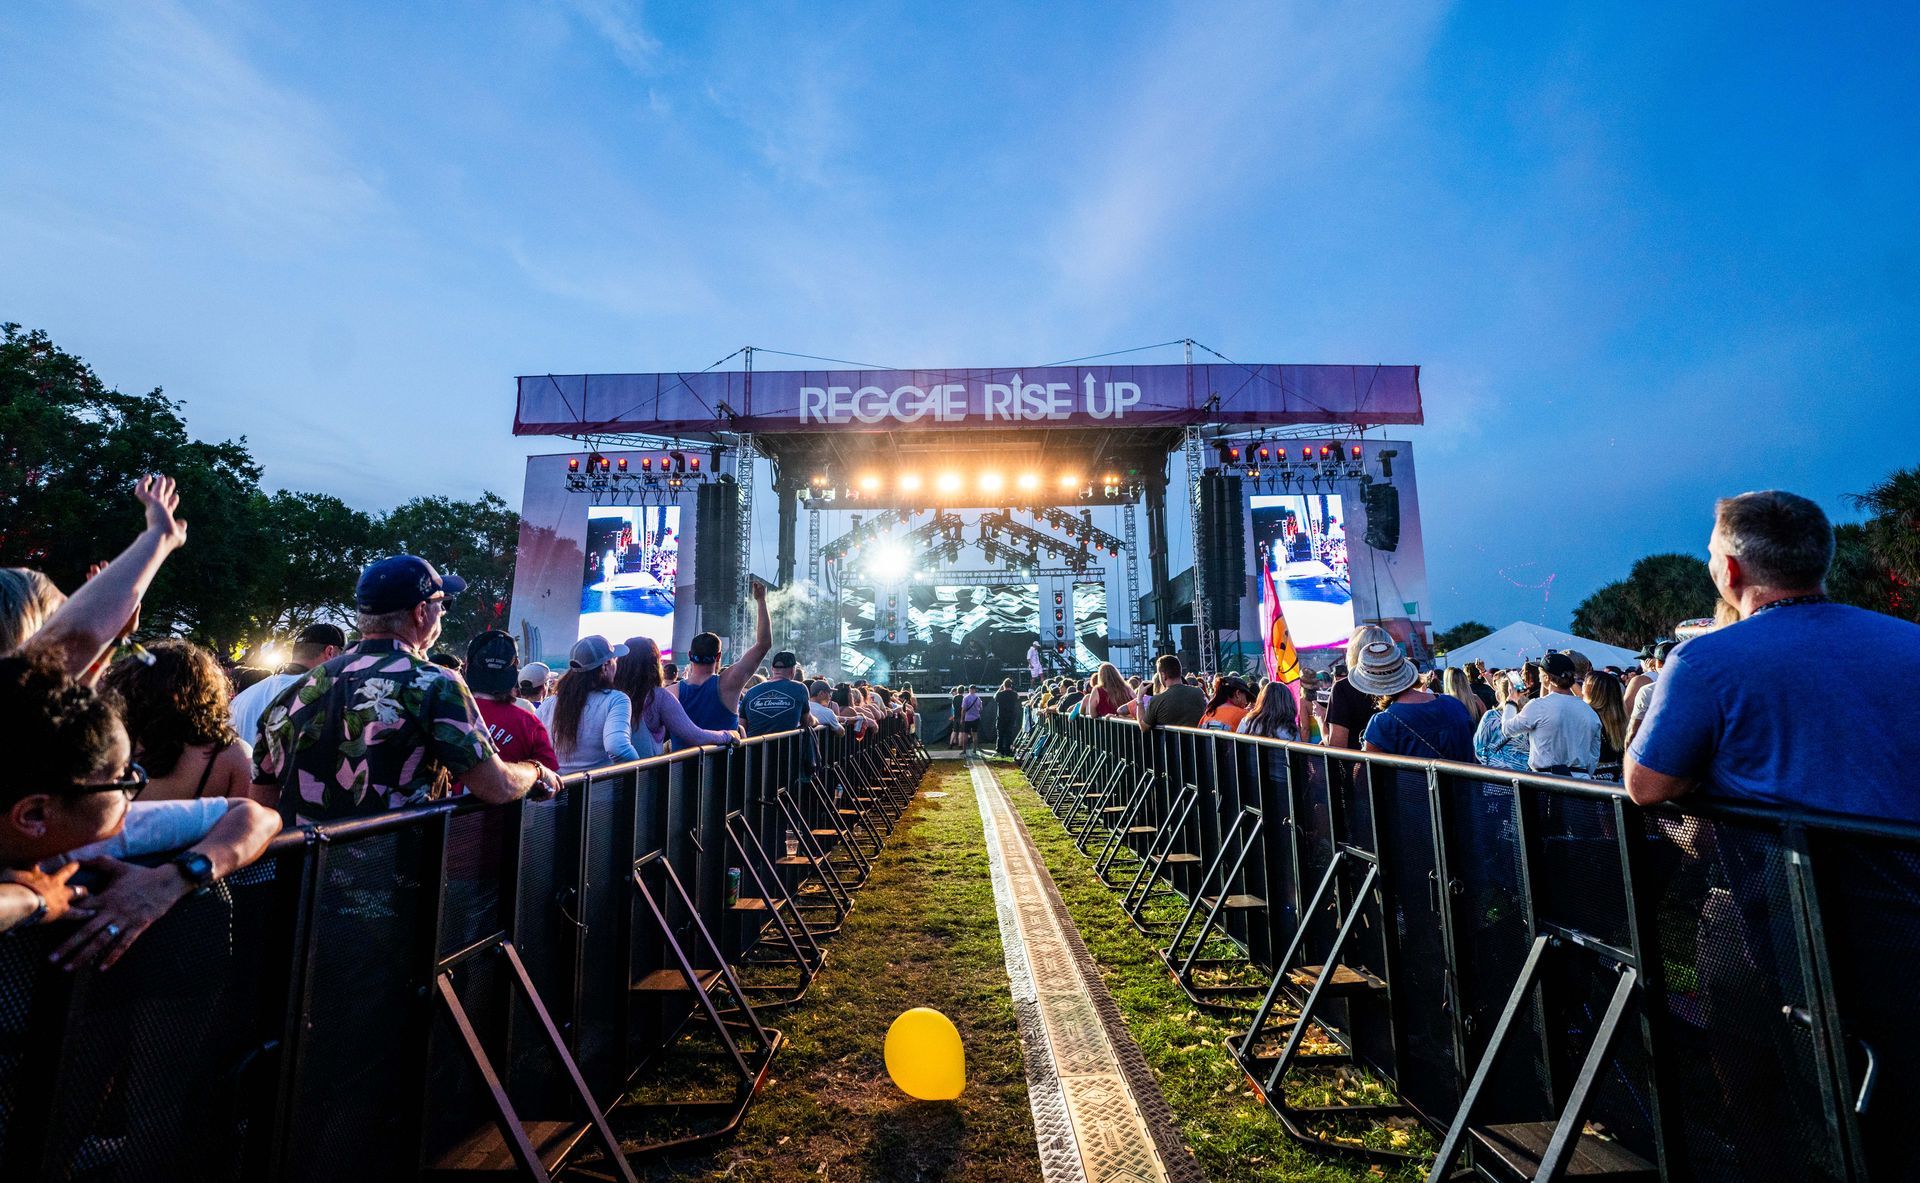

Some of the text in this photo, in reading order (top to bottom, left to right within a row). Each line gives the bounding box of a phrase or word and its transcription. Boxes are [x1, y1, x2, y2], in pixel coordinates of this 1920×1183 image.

[800, 372, 1142, 424] REGGAE RISE UP
[753, 700, 764, 708] The
